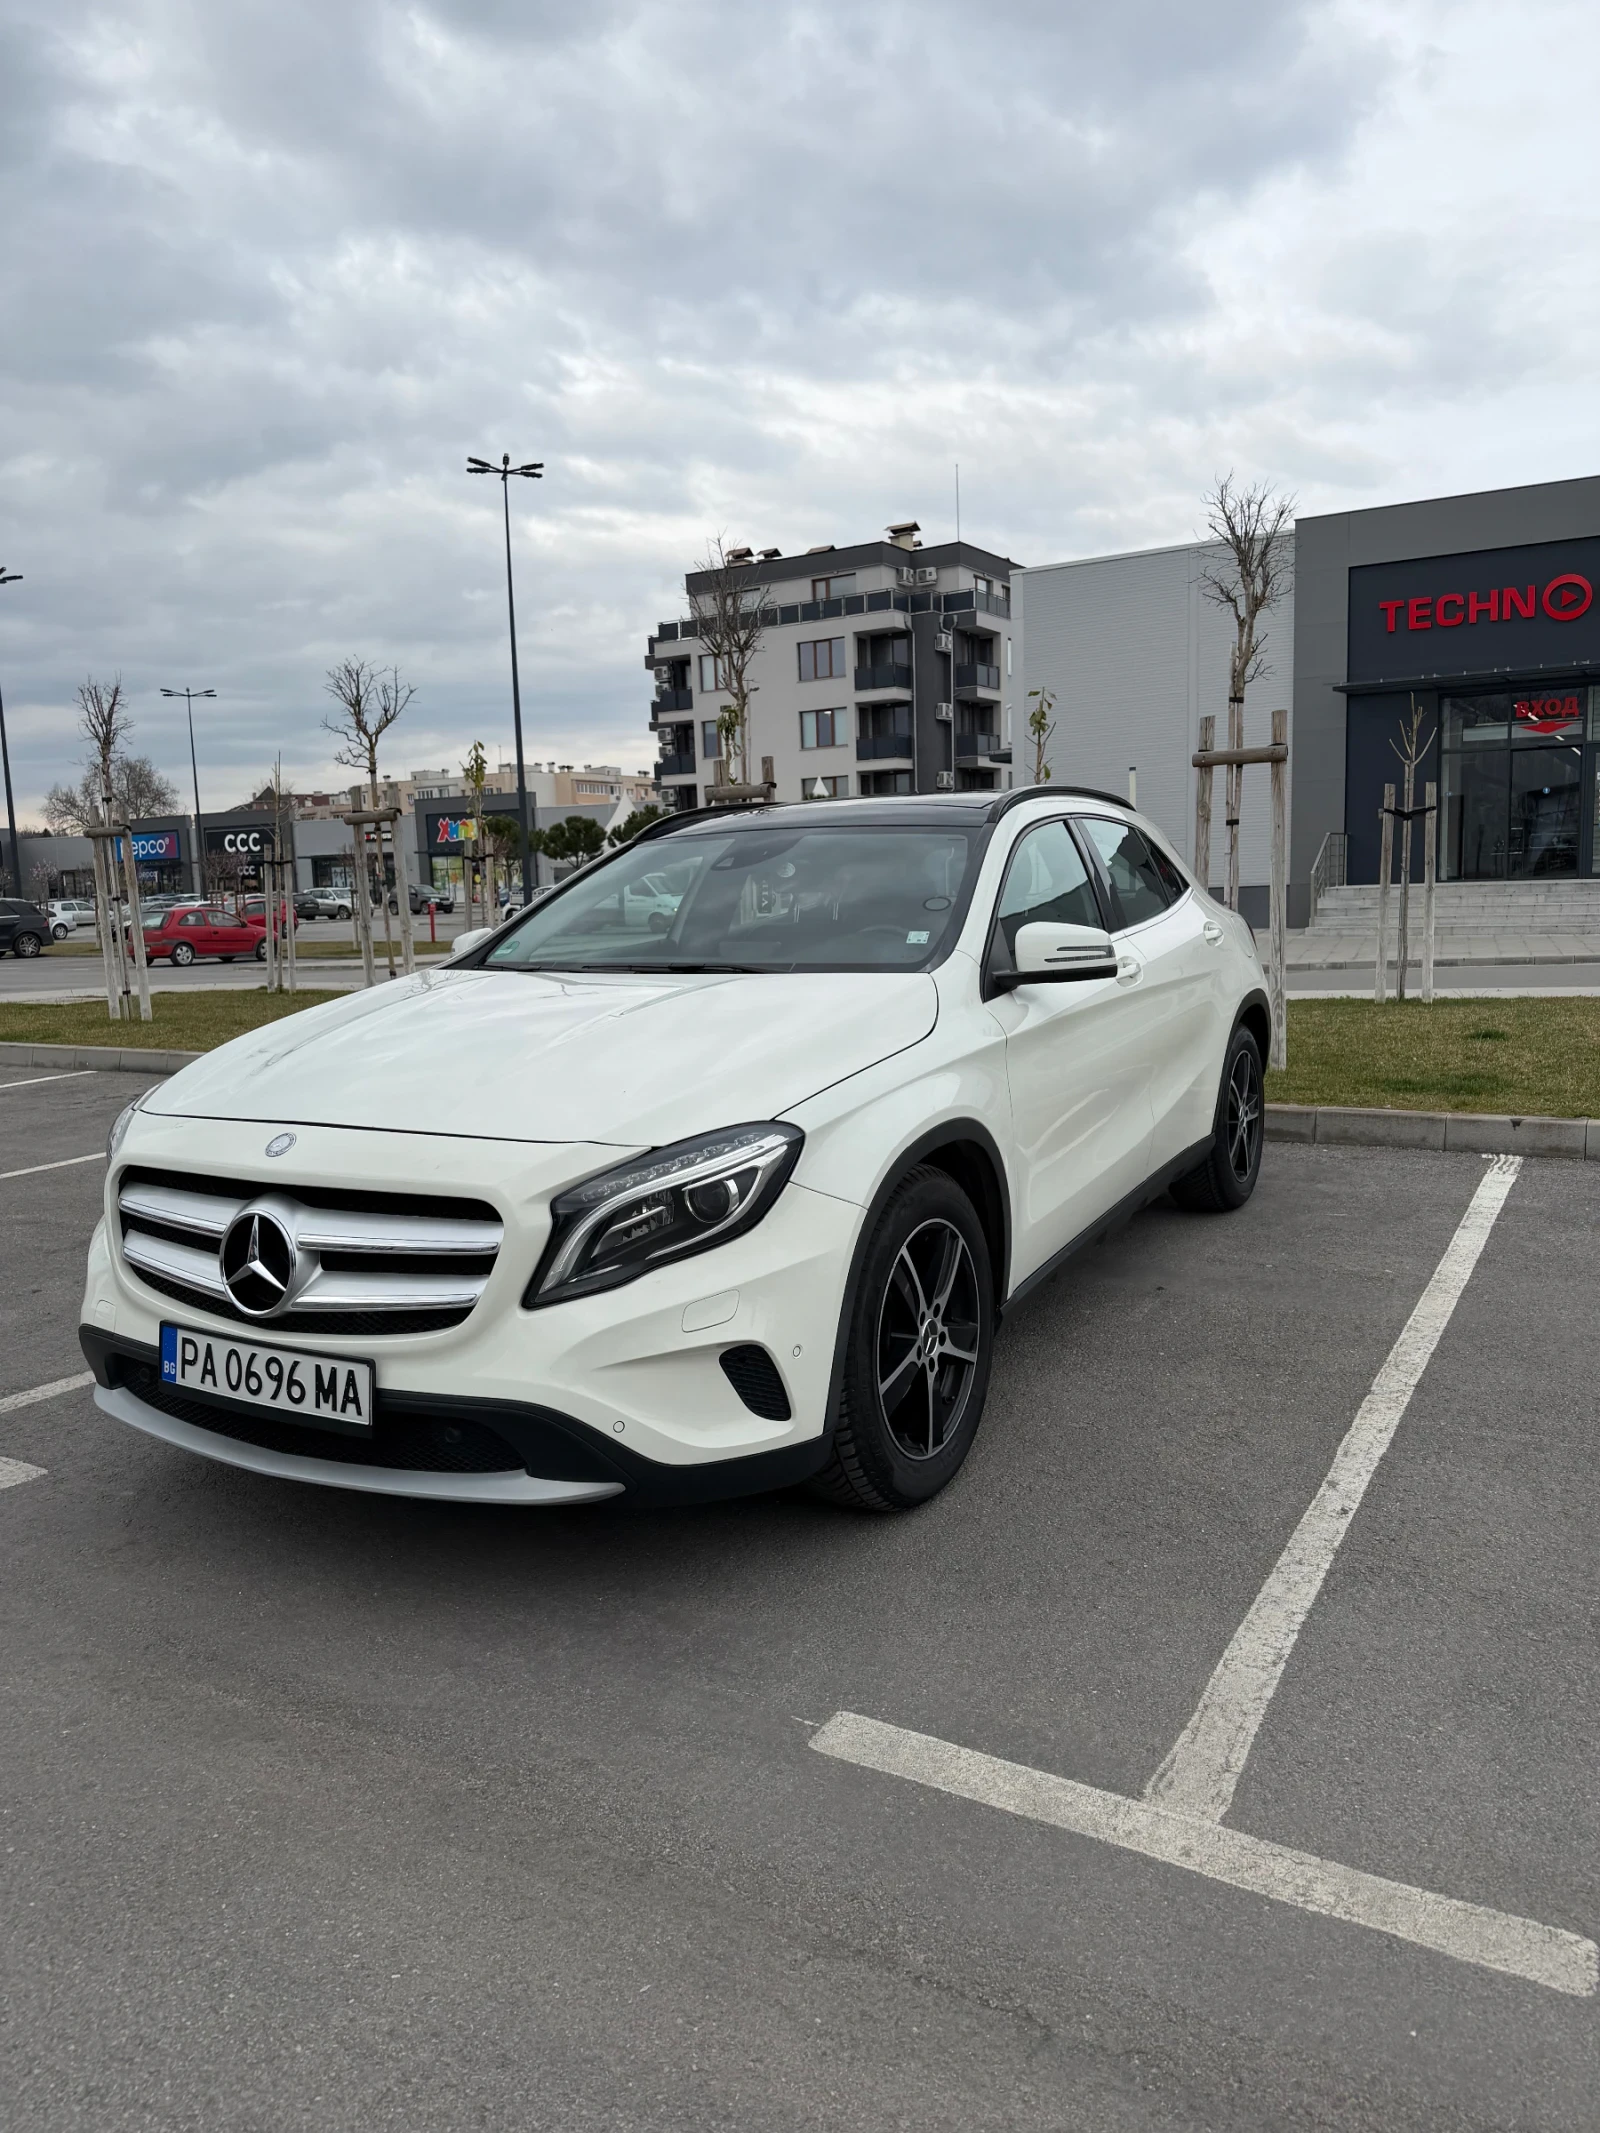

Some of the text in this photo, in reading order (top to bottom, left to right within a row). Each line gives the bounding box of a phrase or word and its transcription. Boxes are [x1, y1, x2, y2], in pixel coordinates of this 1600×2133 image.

[1378, 573, 1593, 633] TECHNO
[1515, 697, 1580, 718] ВХОД
[224, 832, 261, 853] CCC
[163, 1361, 176, 1374] BG
[225, 1347, 307, 1405] 0696
